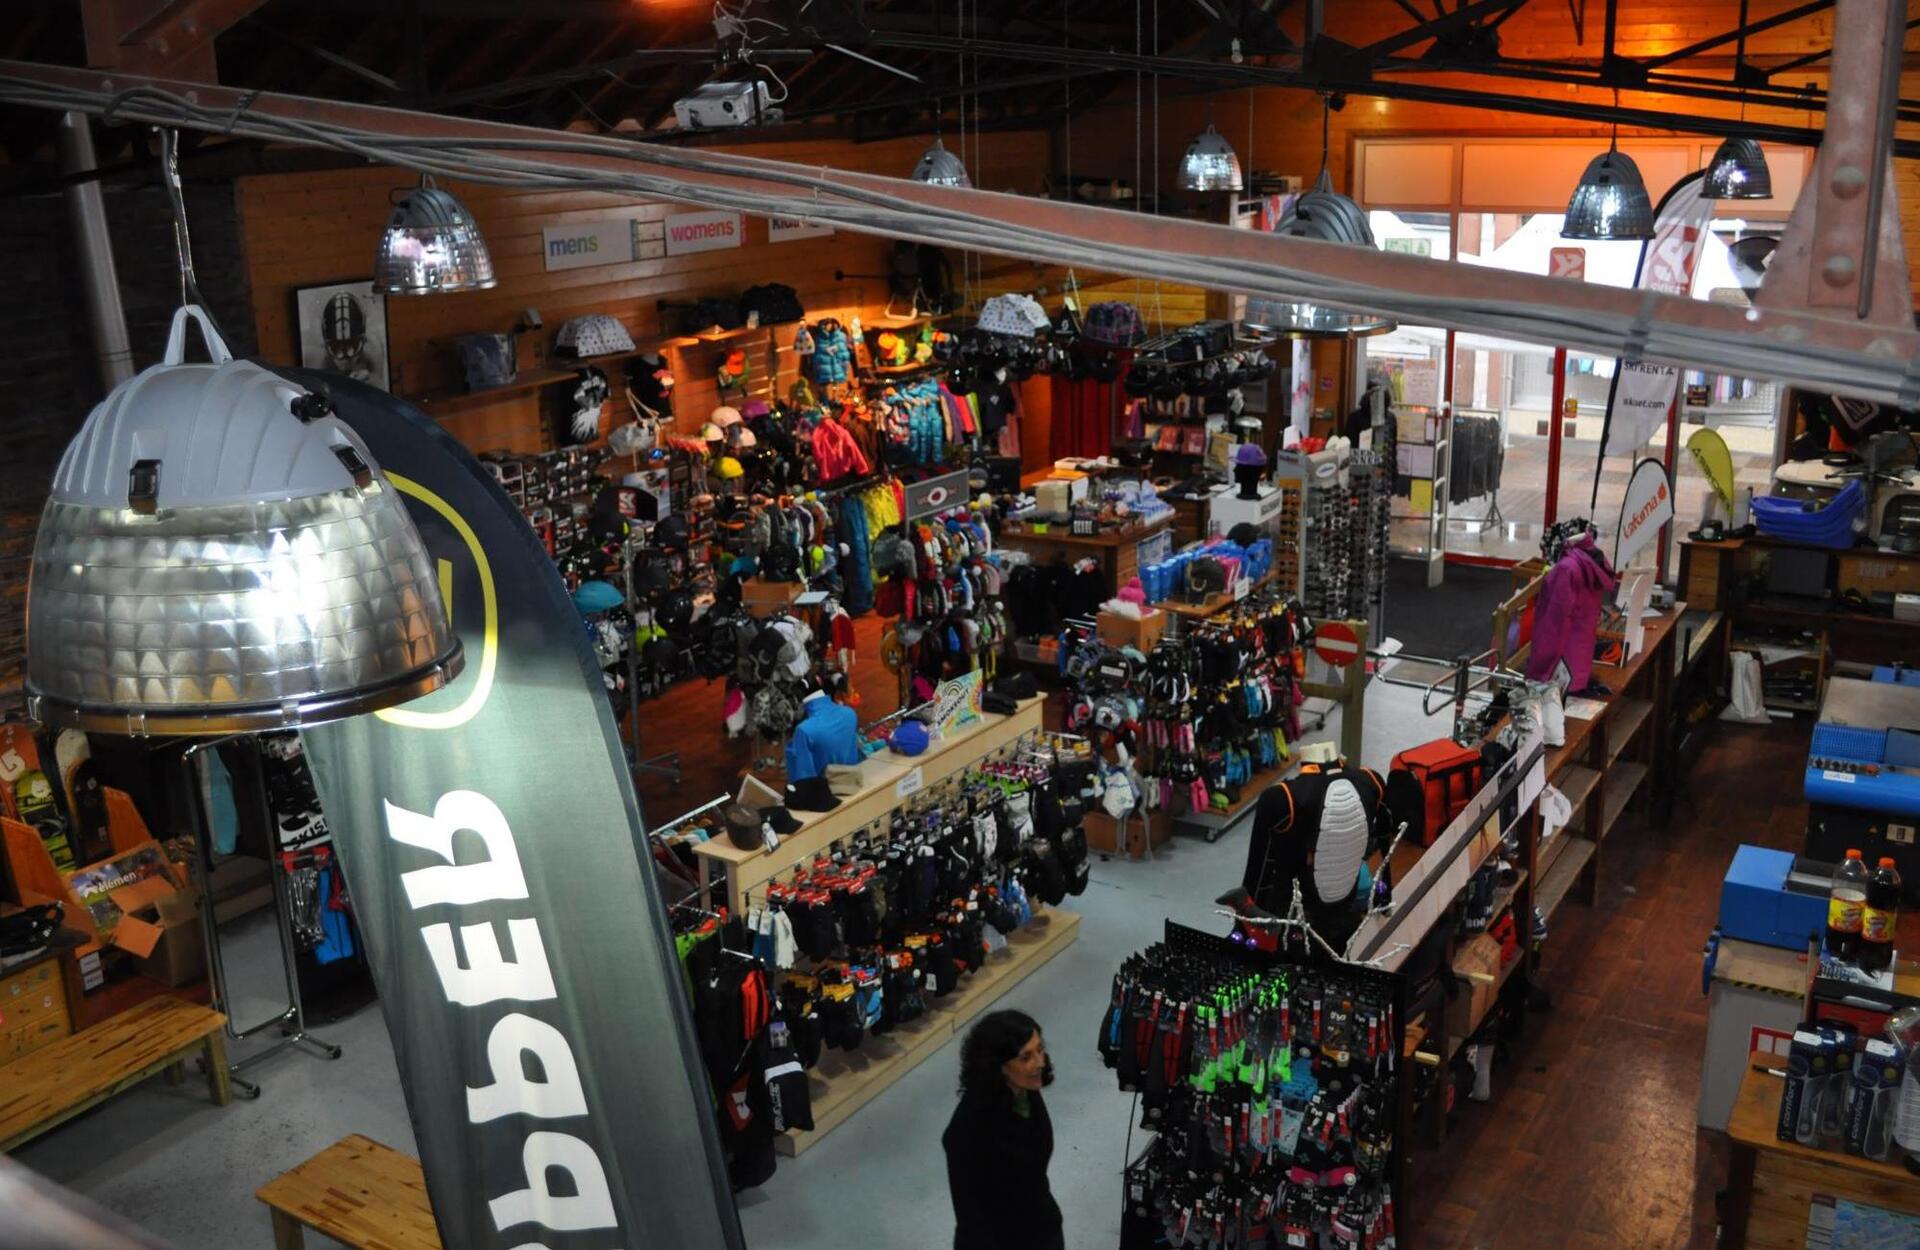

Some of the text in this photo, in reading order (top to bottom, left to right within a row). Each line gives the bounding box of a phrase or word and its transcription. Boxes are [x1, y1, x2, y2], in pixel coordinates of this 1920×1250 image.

[670, 217, 735, 242] womens
[549, 234, 599, 257] mens
[1782, 1078, 1797, 1131] comfort
